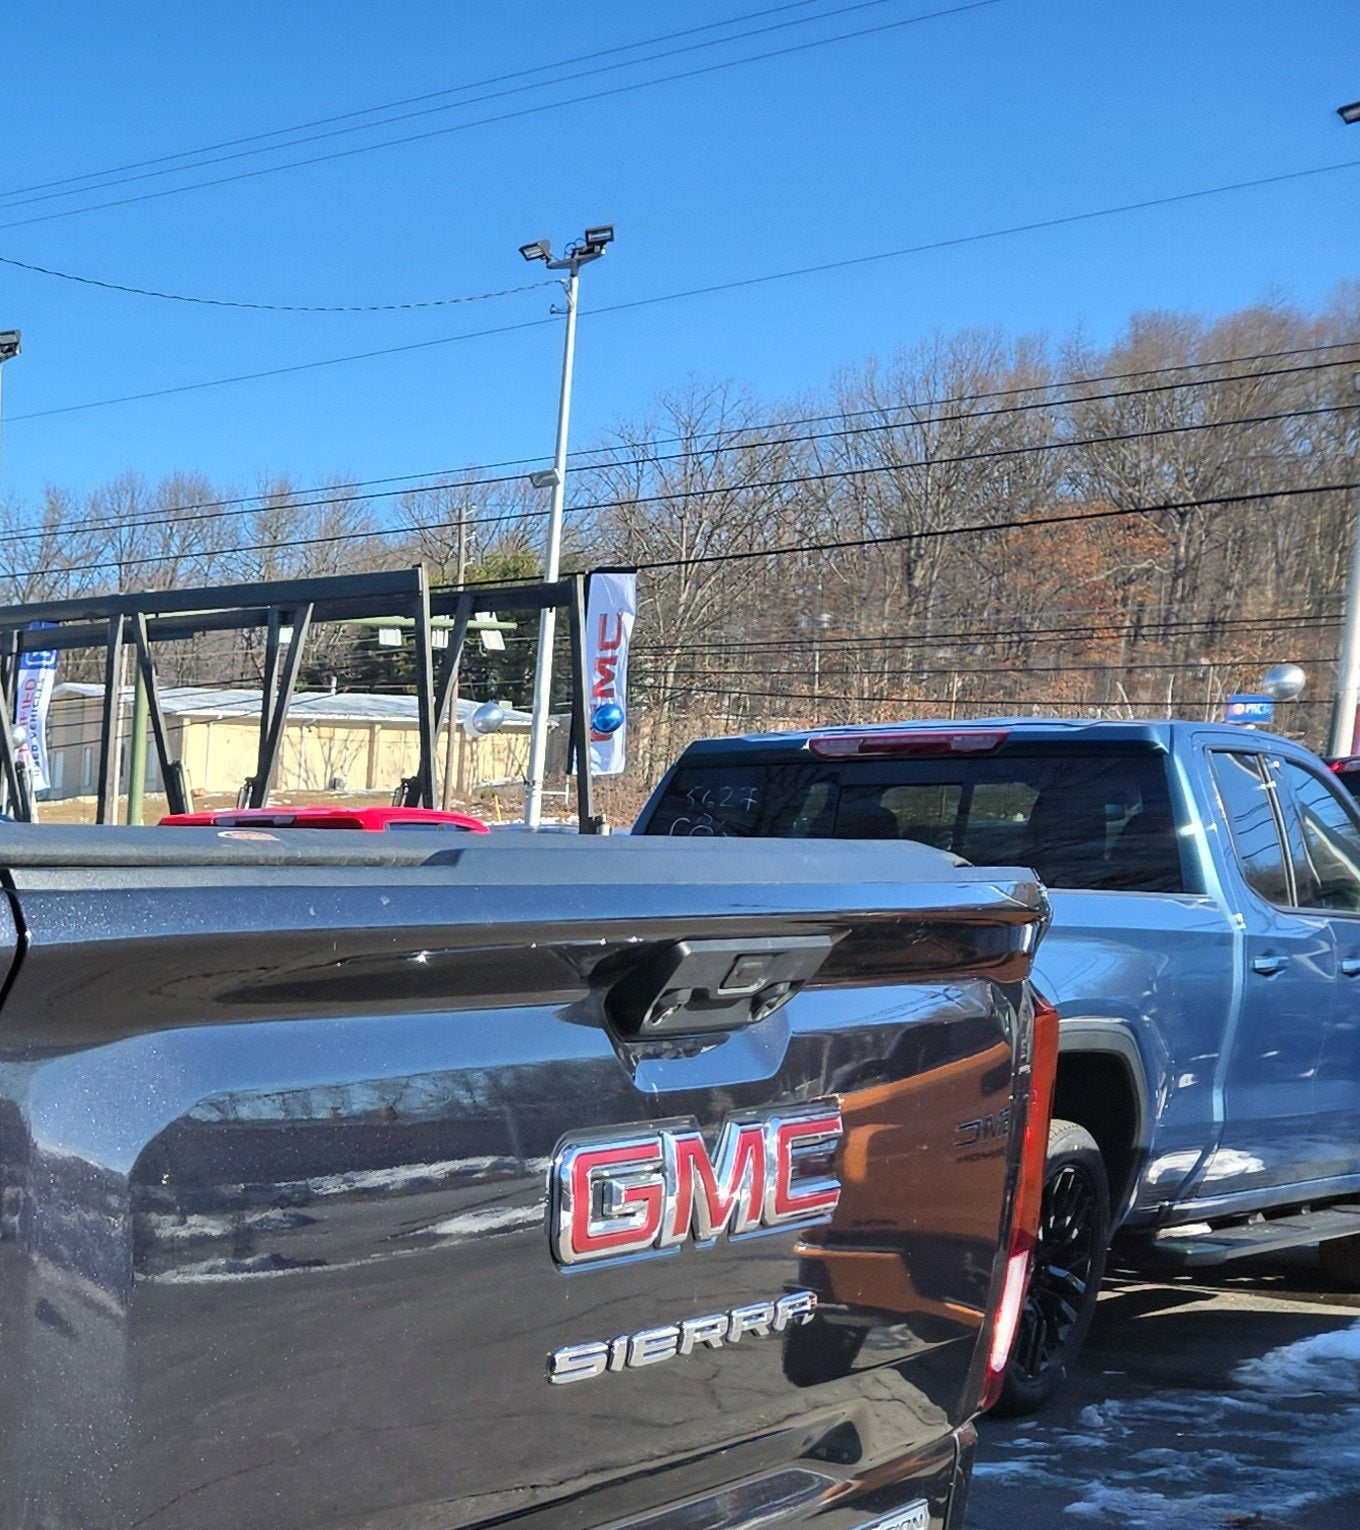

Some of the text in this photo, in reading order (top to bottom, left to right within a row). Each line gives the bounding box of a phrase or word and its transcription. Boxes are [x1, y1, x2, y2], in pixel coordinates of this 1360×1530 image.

[590, 613, 623, 742] MC
[548, 1106, 843, 1275] GMC
[546, 1290, 818, 1385] SIERRA
